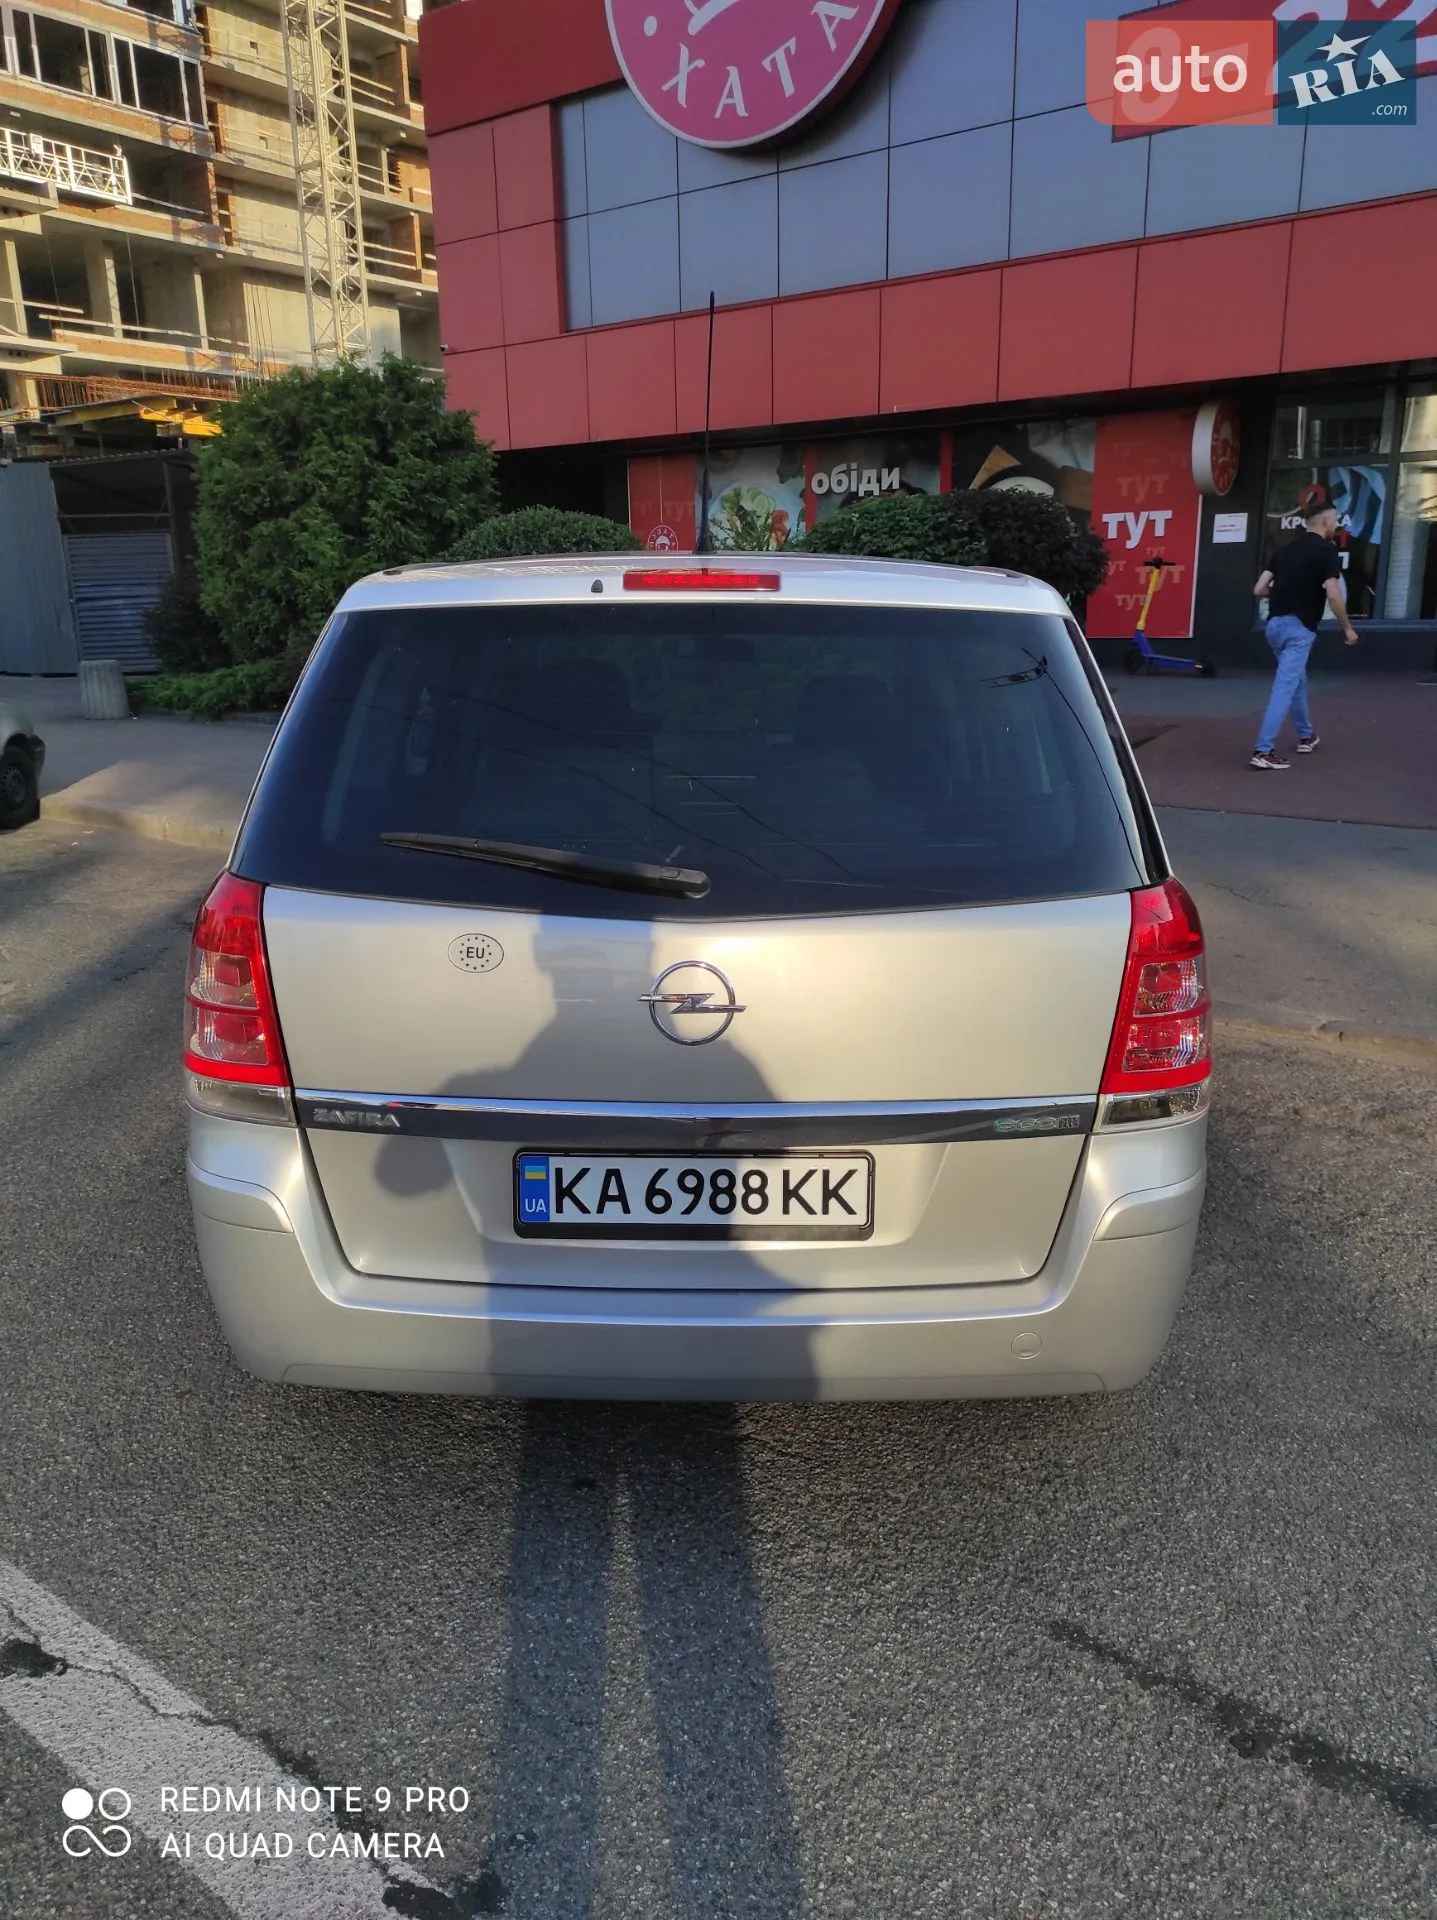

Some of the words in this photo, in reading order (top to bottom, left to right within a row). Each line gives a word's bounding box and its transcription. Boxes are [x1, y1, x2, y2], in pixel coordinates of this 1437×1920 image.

[811, 463, 900, 497] обіди
[1116, 474, 1170, 504] тут
[1102, 510, 1173, 549] тут
[1107, 561, 1126, 575] ут
[466, 946, 485, 959] EU
[525, 1198, 547, 1213] UA
[645, 1168, 769, 1215] 6988
